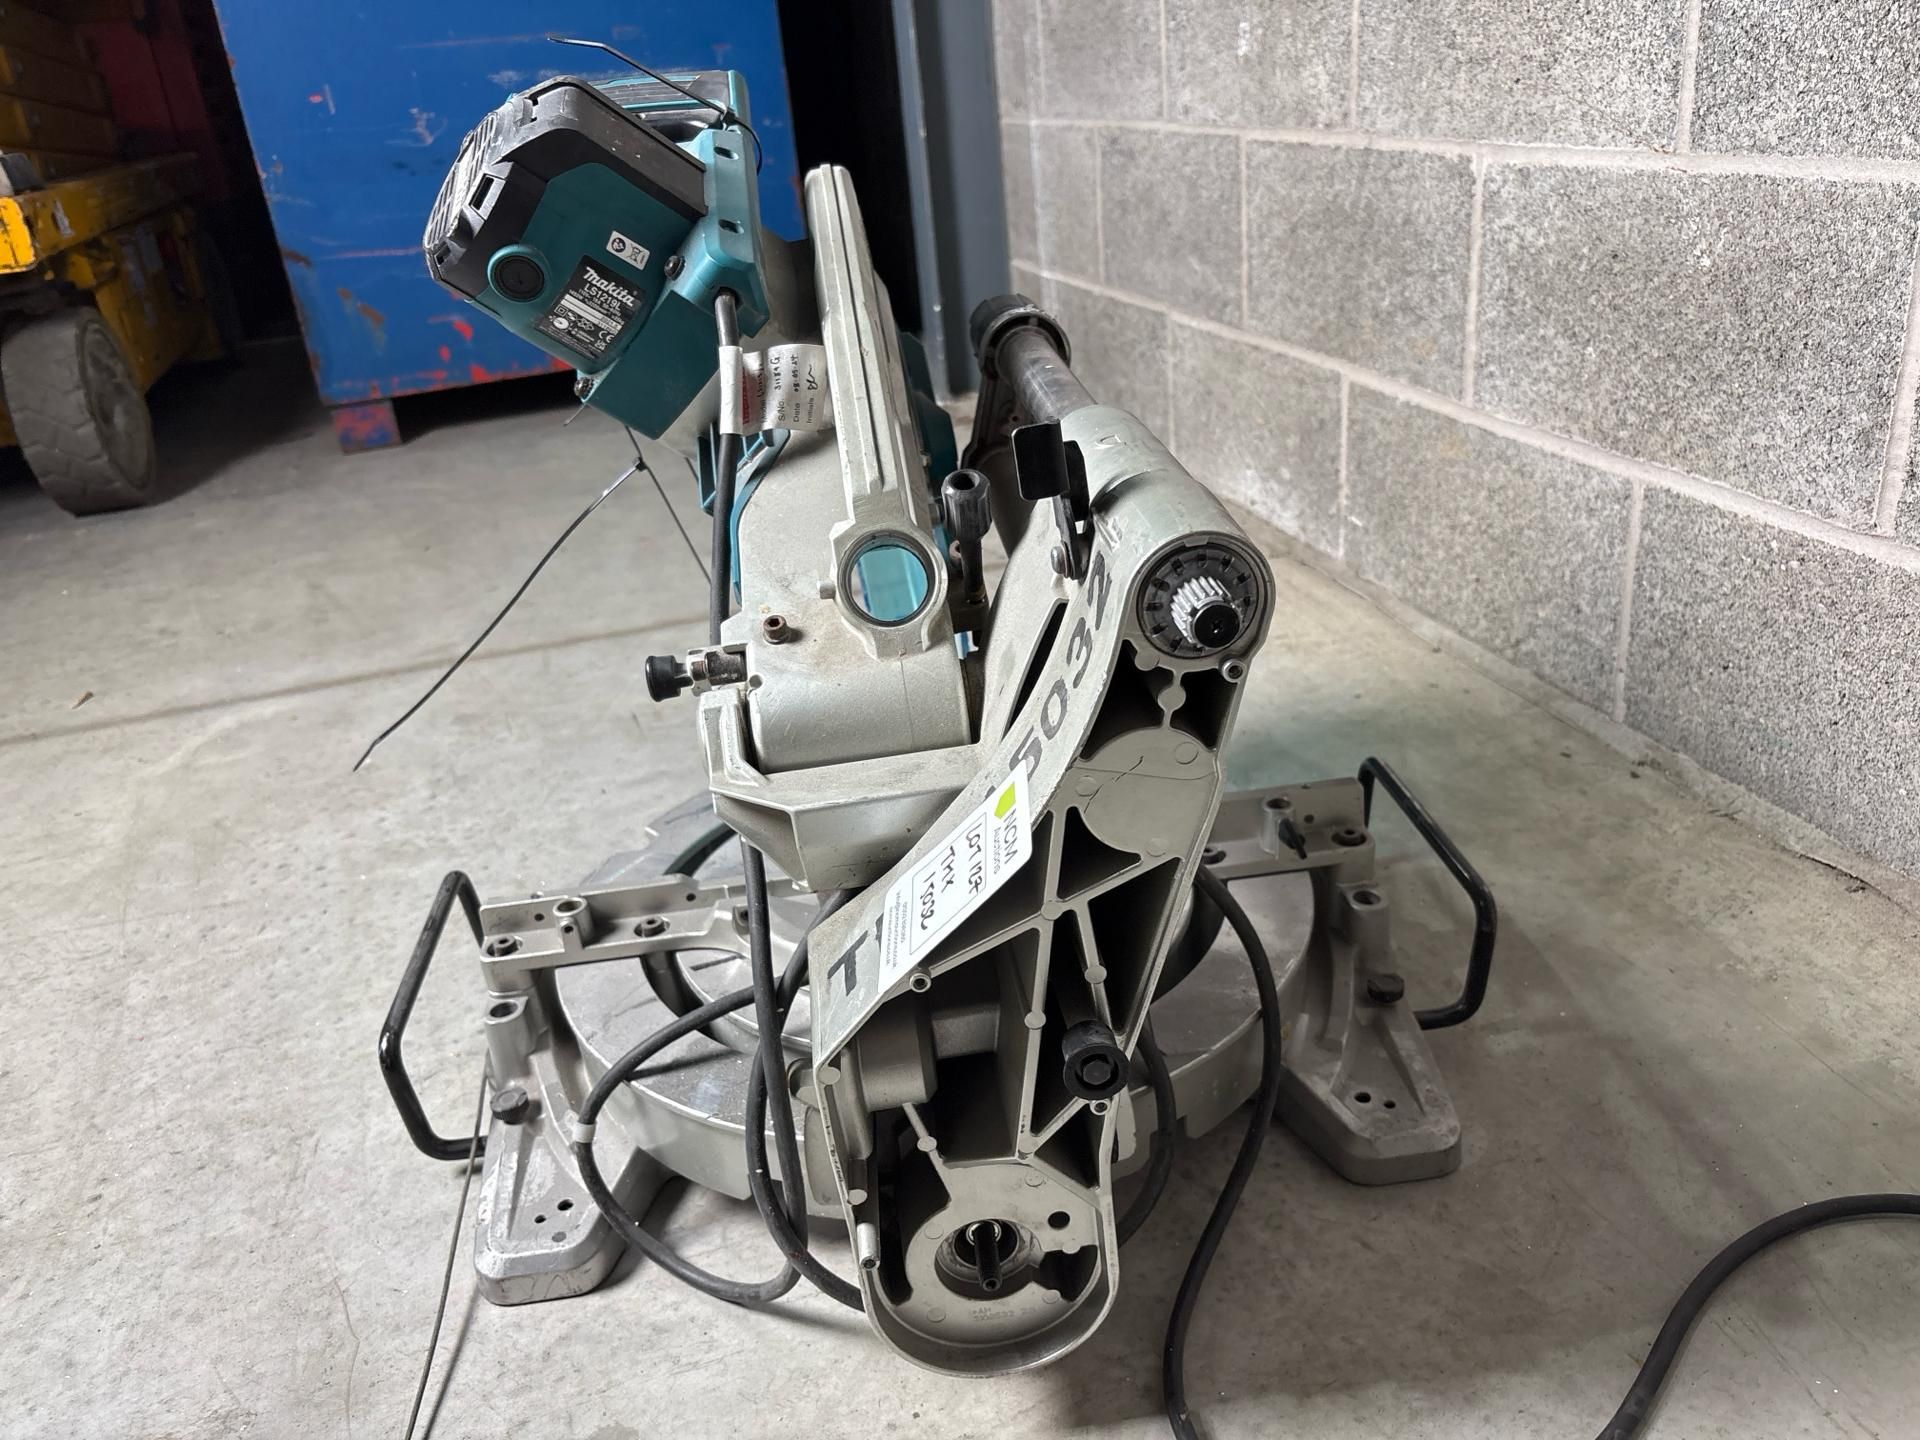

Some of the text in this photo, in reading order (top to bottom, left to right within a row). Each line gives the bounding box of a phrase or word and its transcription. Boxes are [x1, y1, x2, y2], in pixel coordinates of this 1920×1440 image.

[583, 266, 635, 307] Makita
[583, 283, 621, 311] LS1219L
[793, 402, 801, 423] Date
[965, 822, 984, 896] LOT 127
[993, 826, 1002, 875] Auctions
[1003, 808, 1018, 865] NCM
[919, 870, 936, 931] 15032
